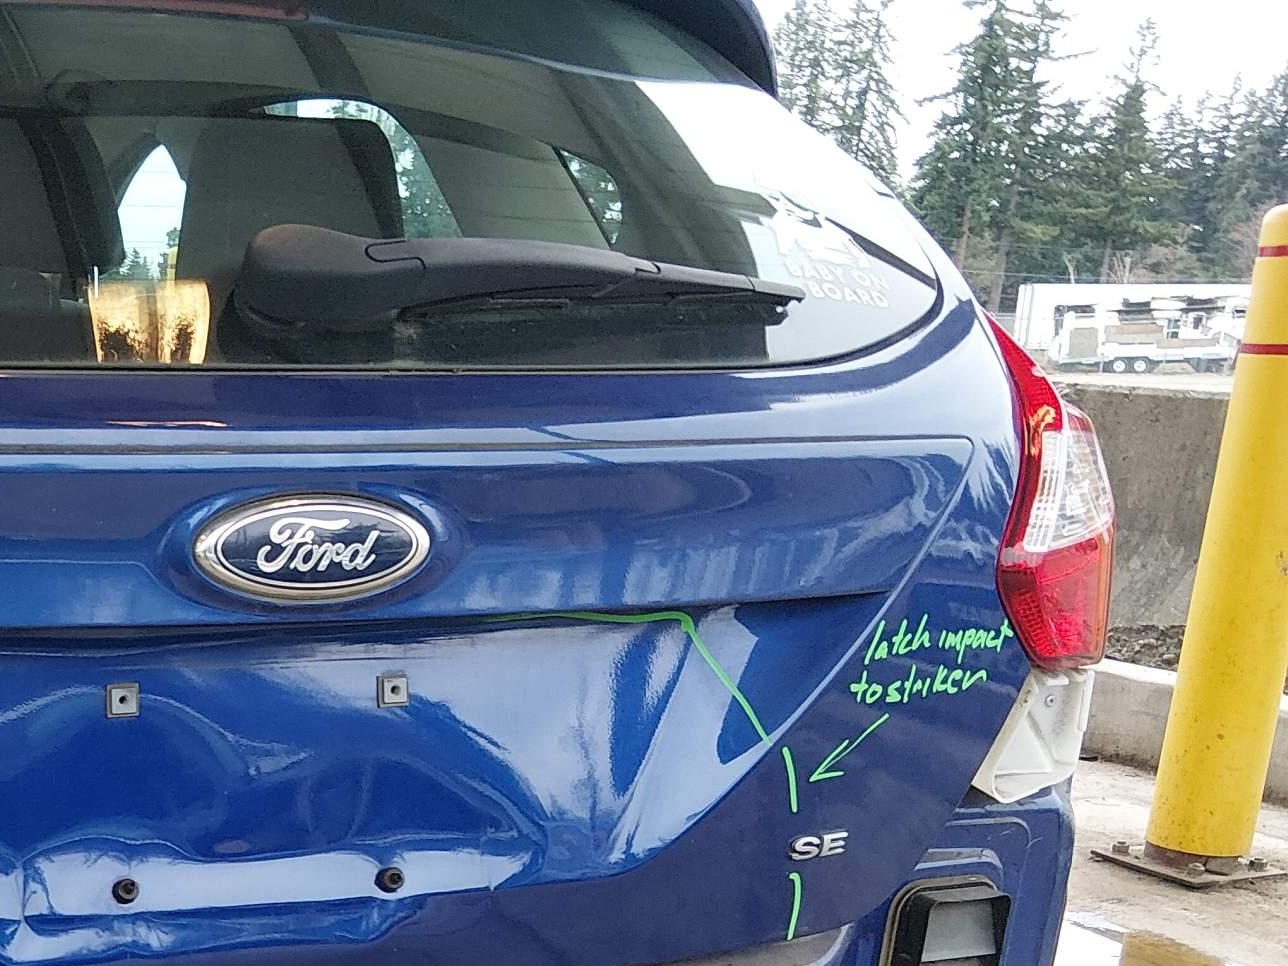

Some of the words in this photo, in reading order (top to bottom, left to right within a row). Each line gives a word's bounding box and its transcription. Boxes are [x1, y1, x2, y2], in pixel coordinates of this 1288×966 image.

[785, 258, 845, 283] BABY
[853, 270, 889, 290] ON
[807, 281, 889, 308] BOARD
[257, 517, 380, 573] Ford
[864, 613, 931, 665] latch
[938, 617, 1014, 664] impact
[788, 831, 849, 861] SE
